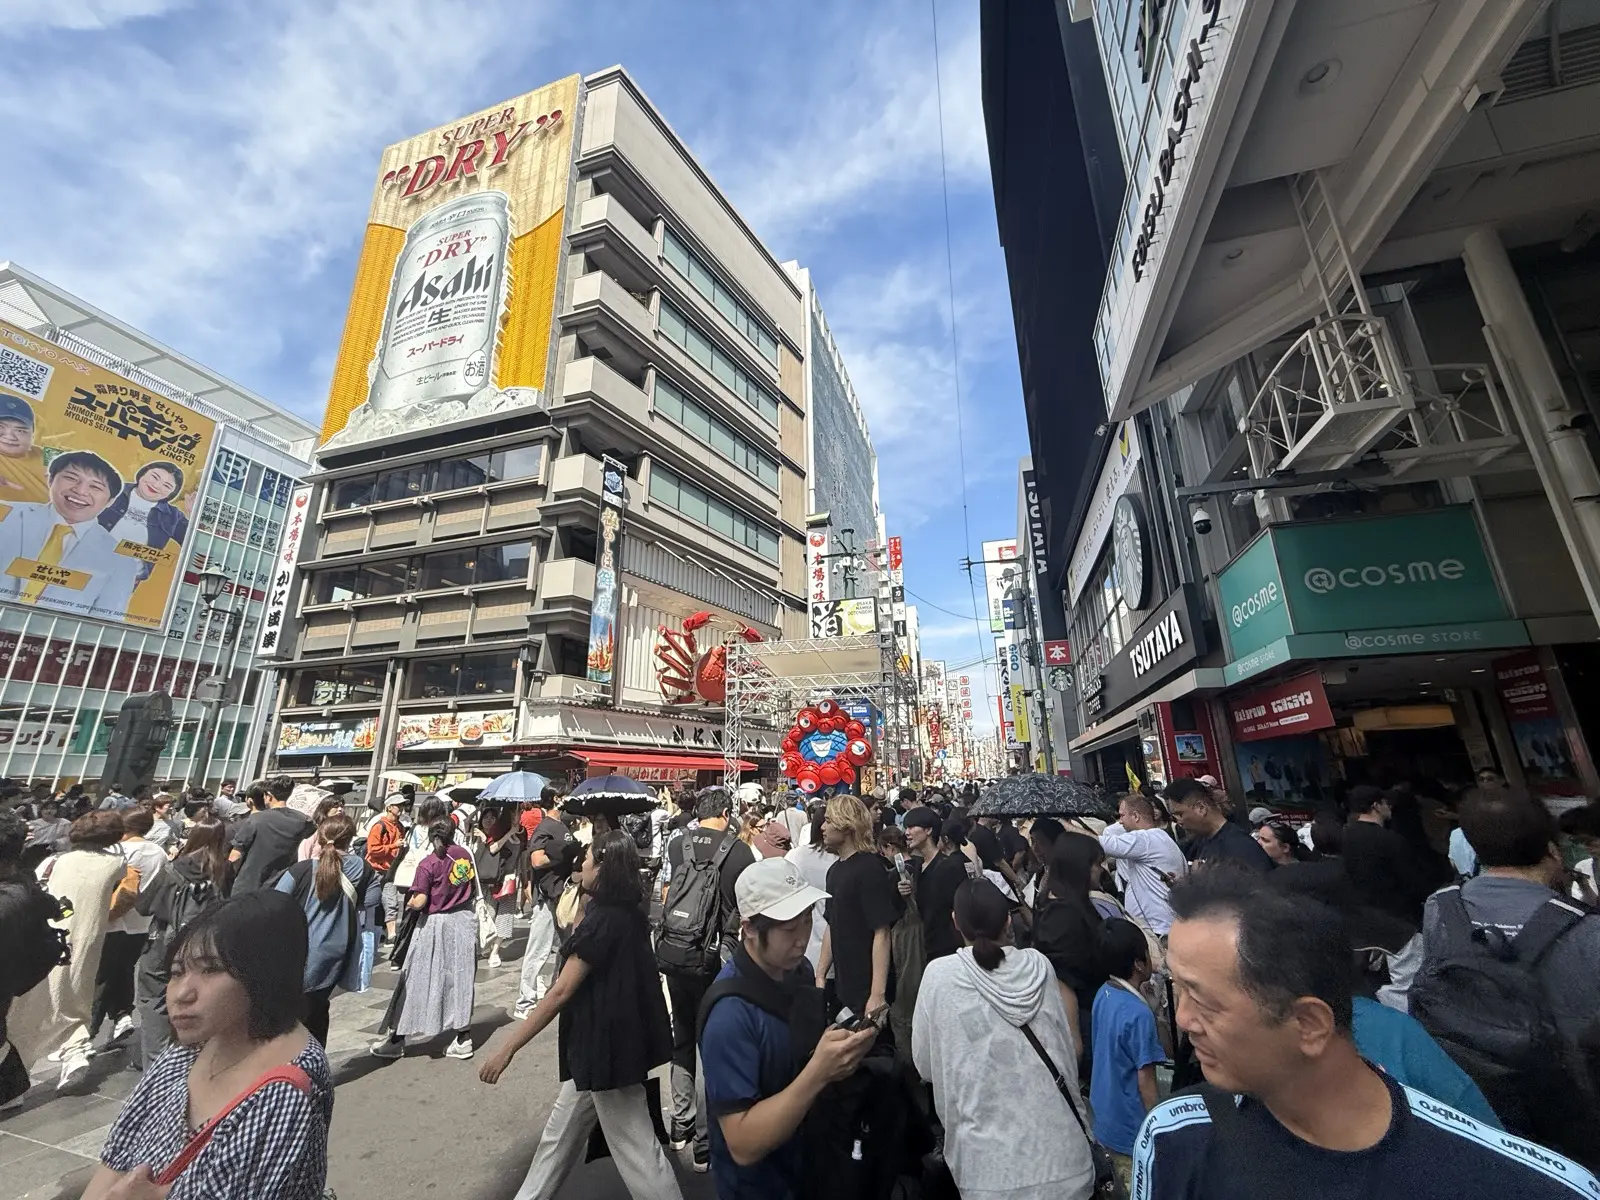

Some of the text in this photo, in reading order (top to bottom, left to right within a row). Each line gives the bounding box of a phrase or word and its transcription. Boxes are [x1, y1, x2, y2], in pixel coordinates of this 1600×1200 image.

[439, 106, 515, 147] SUPER
[437, 229, 471, 247] SUPER
[397, 254, 494, 318] Asahi
[427, 307, 452, 328] 生
[1, 327, 57, 360] TOKYO
[407, 334, 464, 358] スーパードライ
[416, 373, 442, 386] 生ビール
[66, 403, 106, 424] SHIMOFURI
[69, 387, 202, 451] スーパーキング
[94, 384, 189, 432] 霜降り明星 せいやの
[64, 410, 113, 435] MYOJO'S SEIYA
[159, 448, 196, 466] KING TV
[166, 444, 196, 461] SUPER
[285, 511, 304, 566] 本場の味
[36, 564, 71, 579] せいや
[811, 552, 825, 601] 本場の味
[1304, 559, 1466, 594] @cosme
[261, 570, 291, 650] かに道楽
[1232, 581, 1277, 628] @cosme
[1129, 610, 1184, 678] TSUTAYA
[1345, 630, 1483, 650] @cosme STORE
[56, 647, 93, 666] 3F
[1048, 645, 1066, 661] 本
[1237, 658, 1259, 676] @cosme
[1169, 1102, 1206, 1118] umbro
[1419, 1100, 1478, 1131] umbro
[1500, 1138, 1567, 1172] umbro
